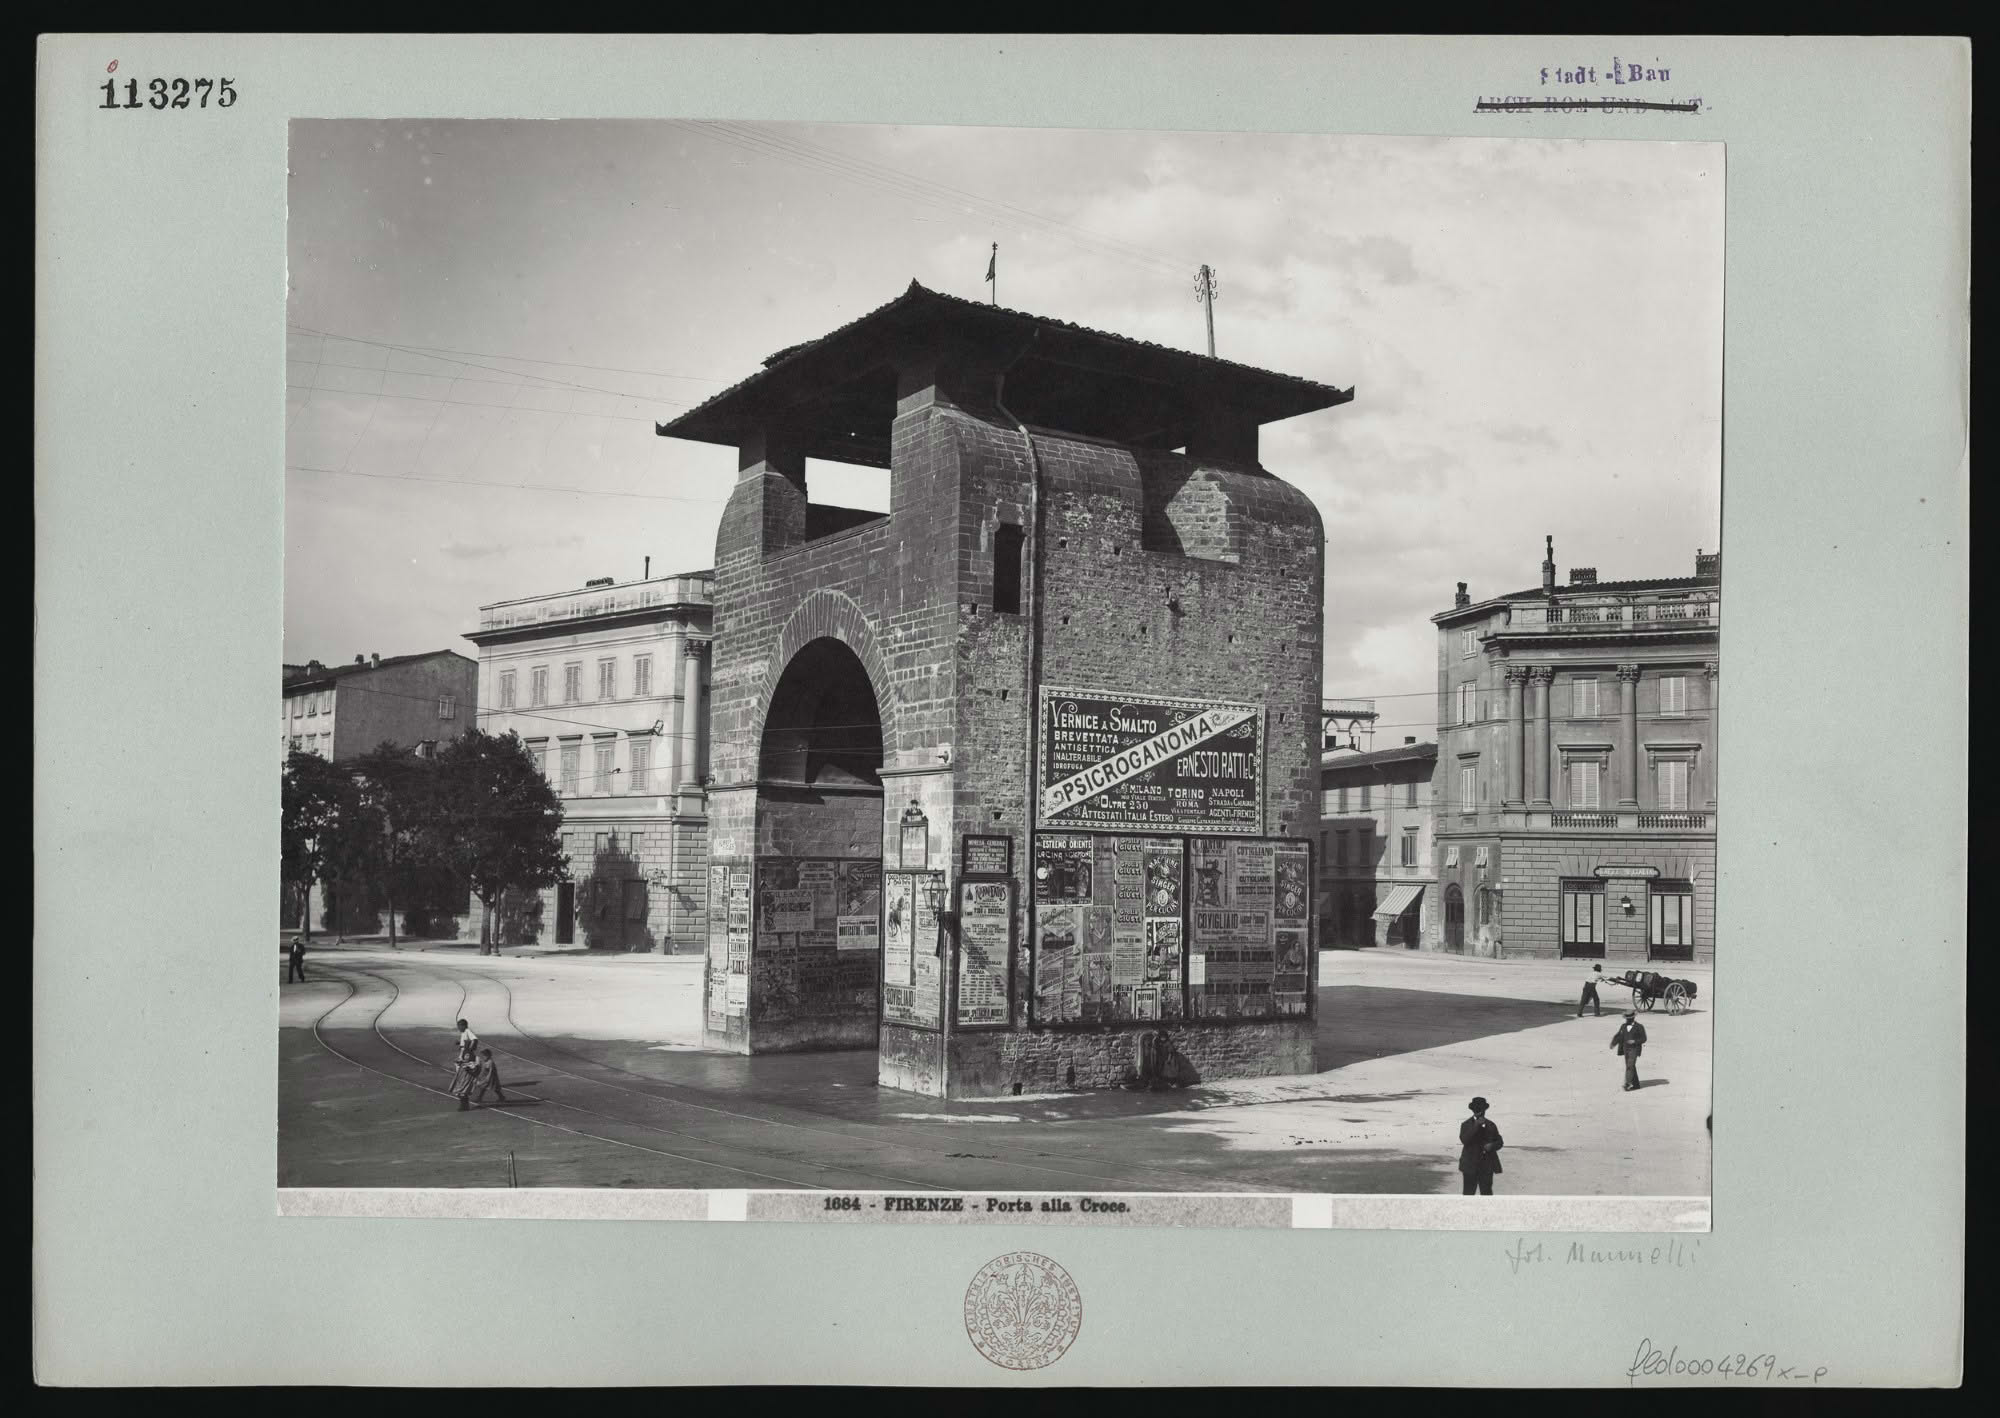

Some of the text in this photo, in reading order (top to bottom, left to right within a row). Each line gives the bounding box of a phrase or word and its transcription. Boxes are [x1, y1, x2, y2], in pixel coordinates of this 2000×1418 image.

[99, 77, 238, 110] 113275
[1054, 730, 1119, 745] BREVETTATA
[1054, 742, 1116, 755] ANTISETTICA
[1053, 751, 1102, 763] INALTERABILE
[1062, 717, 1213, 802] PSICROGANOMA
[1177, 751, 1219, 778] ERNESTO
[1130, 784, 1245, 799] MILANO TORINO NAPOLI
[1176, 800, 1199, 808] ROMA
[1081, 804, 1122, 820] ATTESTATI
[1124, 809, 1147, 821] ITALIA
